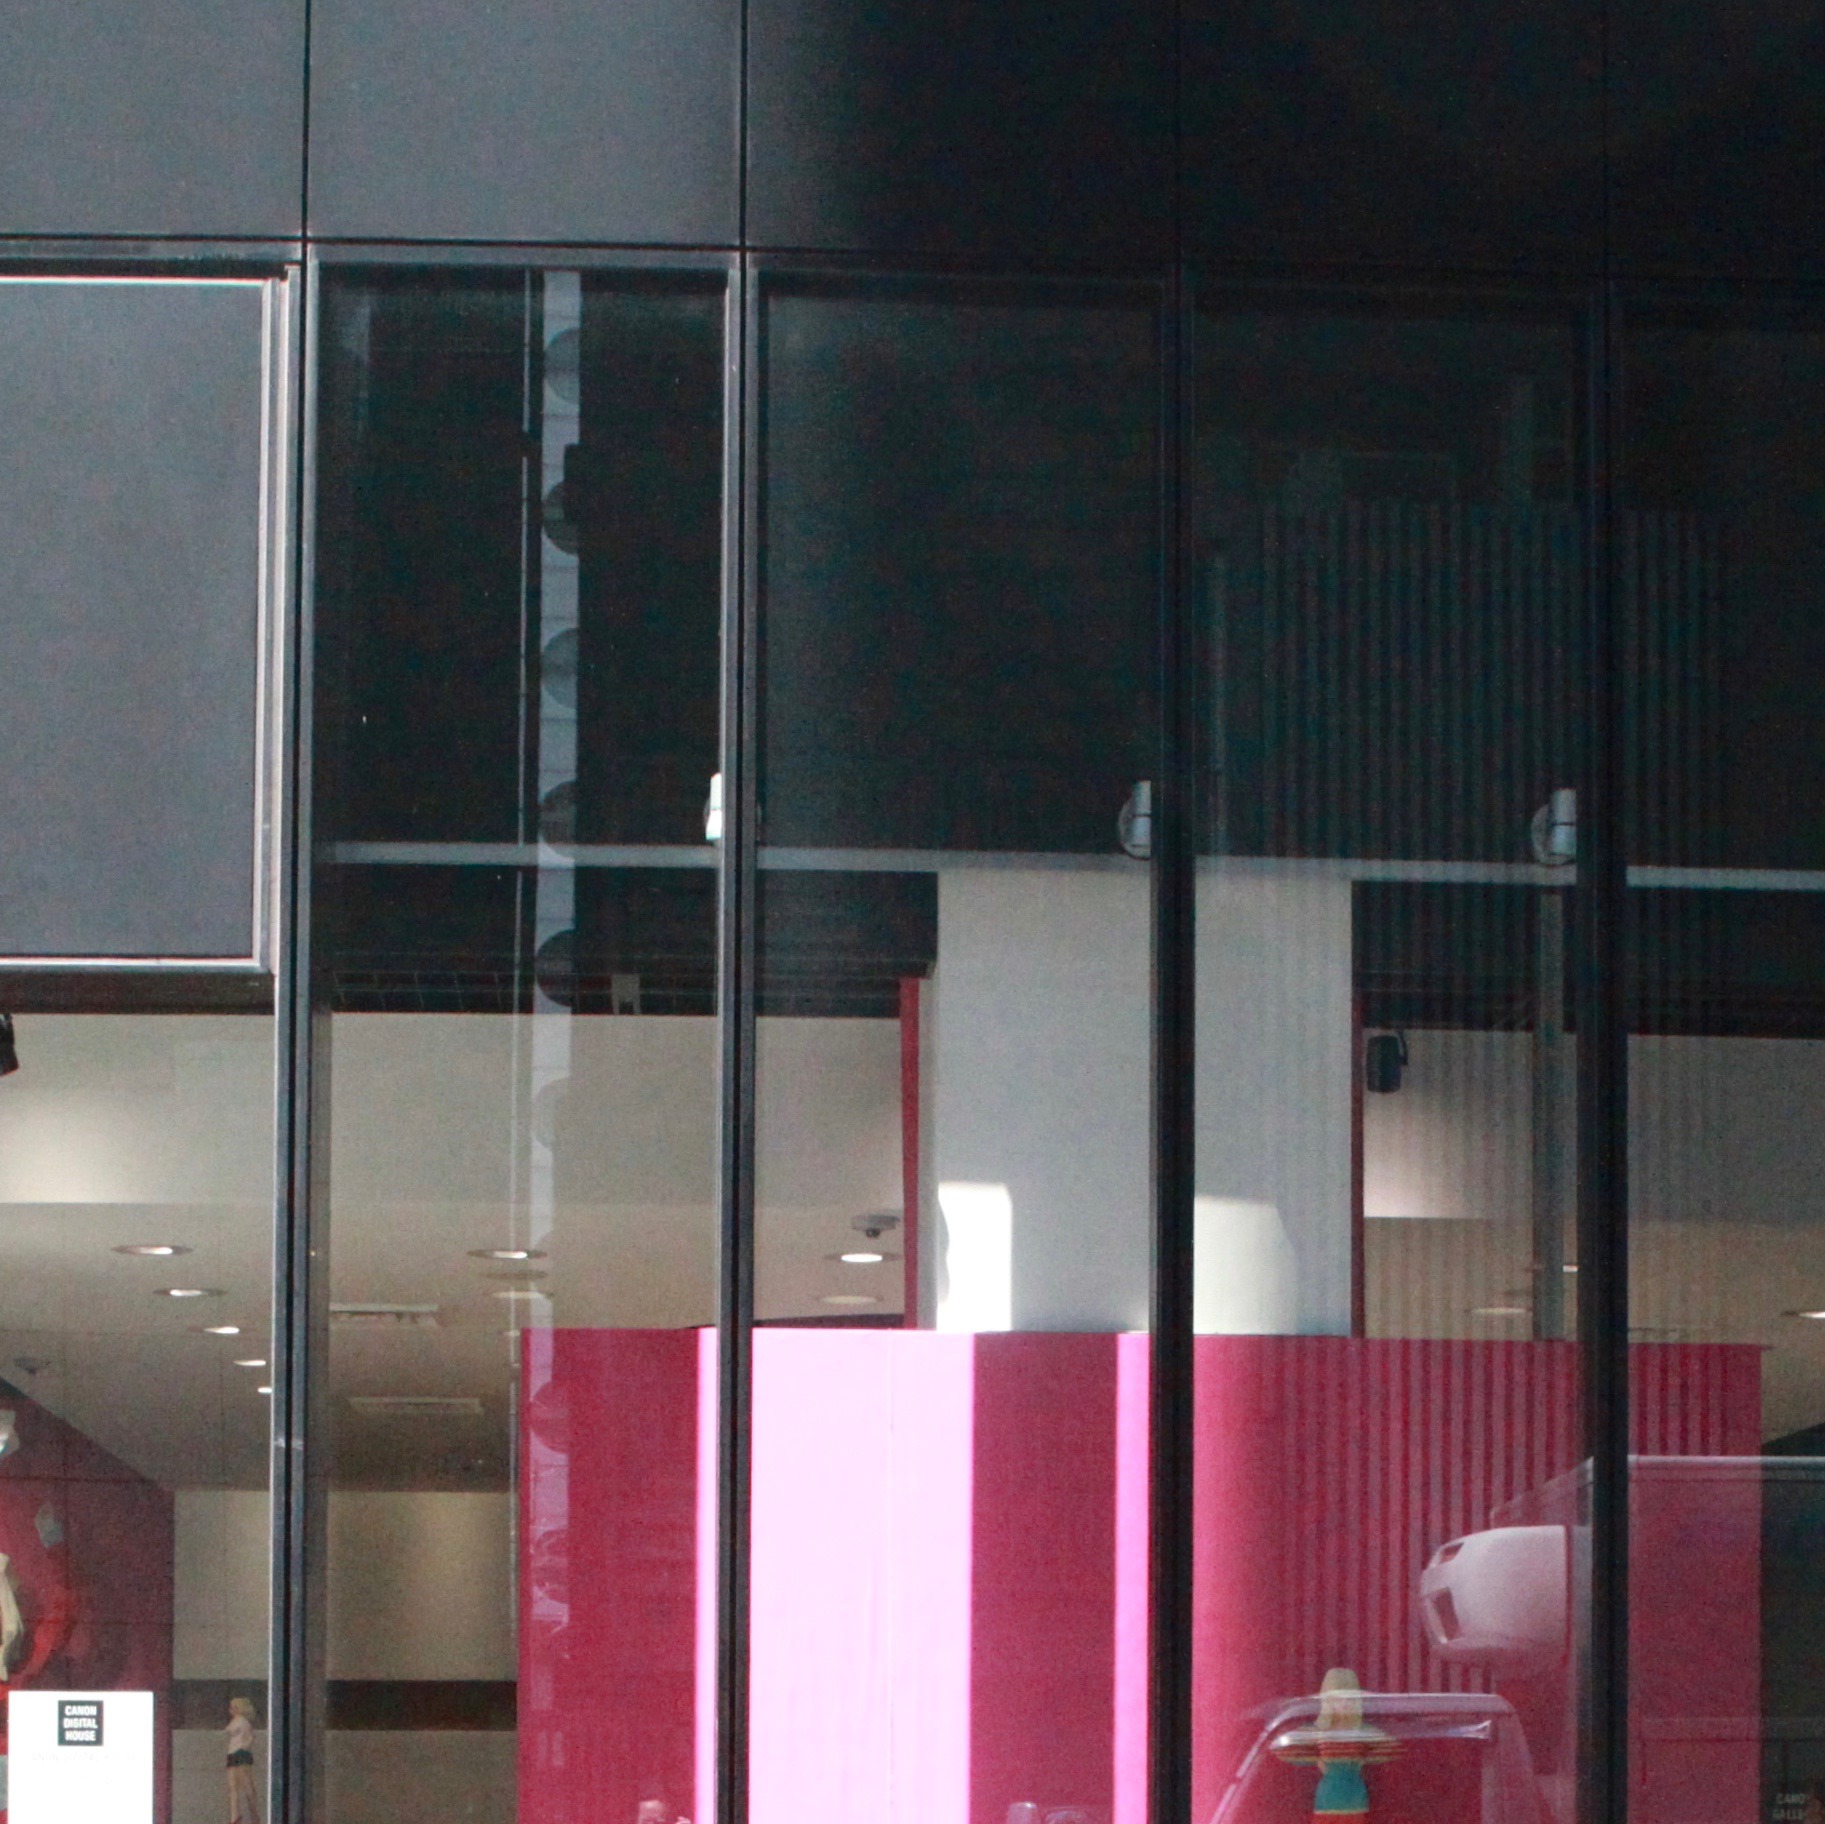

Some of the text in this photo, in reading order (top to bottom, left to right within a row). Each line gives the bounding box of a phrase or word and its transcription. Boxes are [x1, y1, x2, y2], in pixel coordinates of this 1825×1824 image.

[64, 1705, 97, 1716] CANON
[63, 1717, 99, 1729] DIGITAL
[65, 1730, 96, 1741] HOUSE
[1776, 1793, 1806, 1804] CANO
